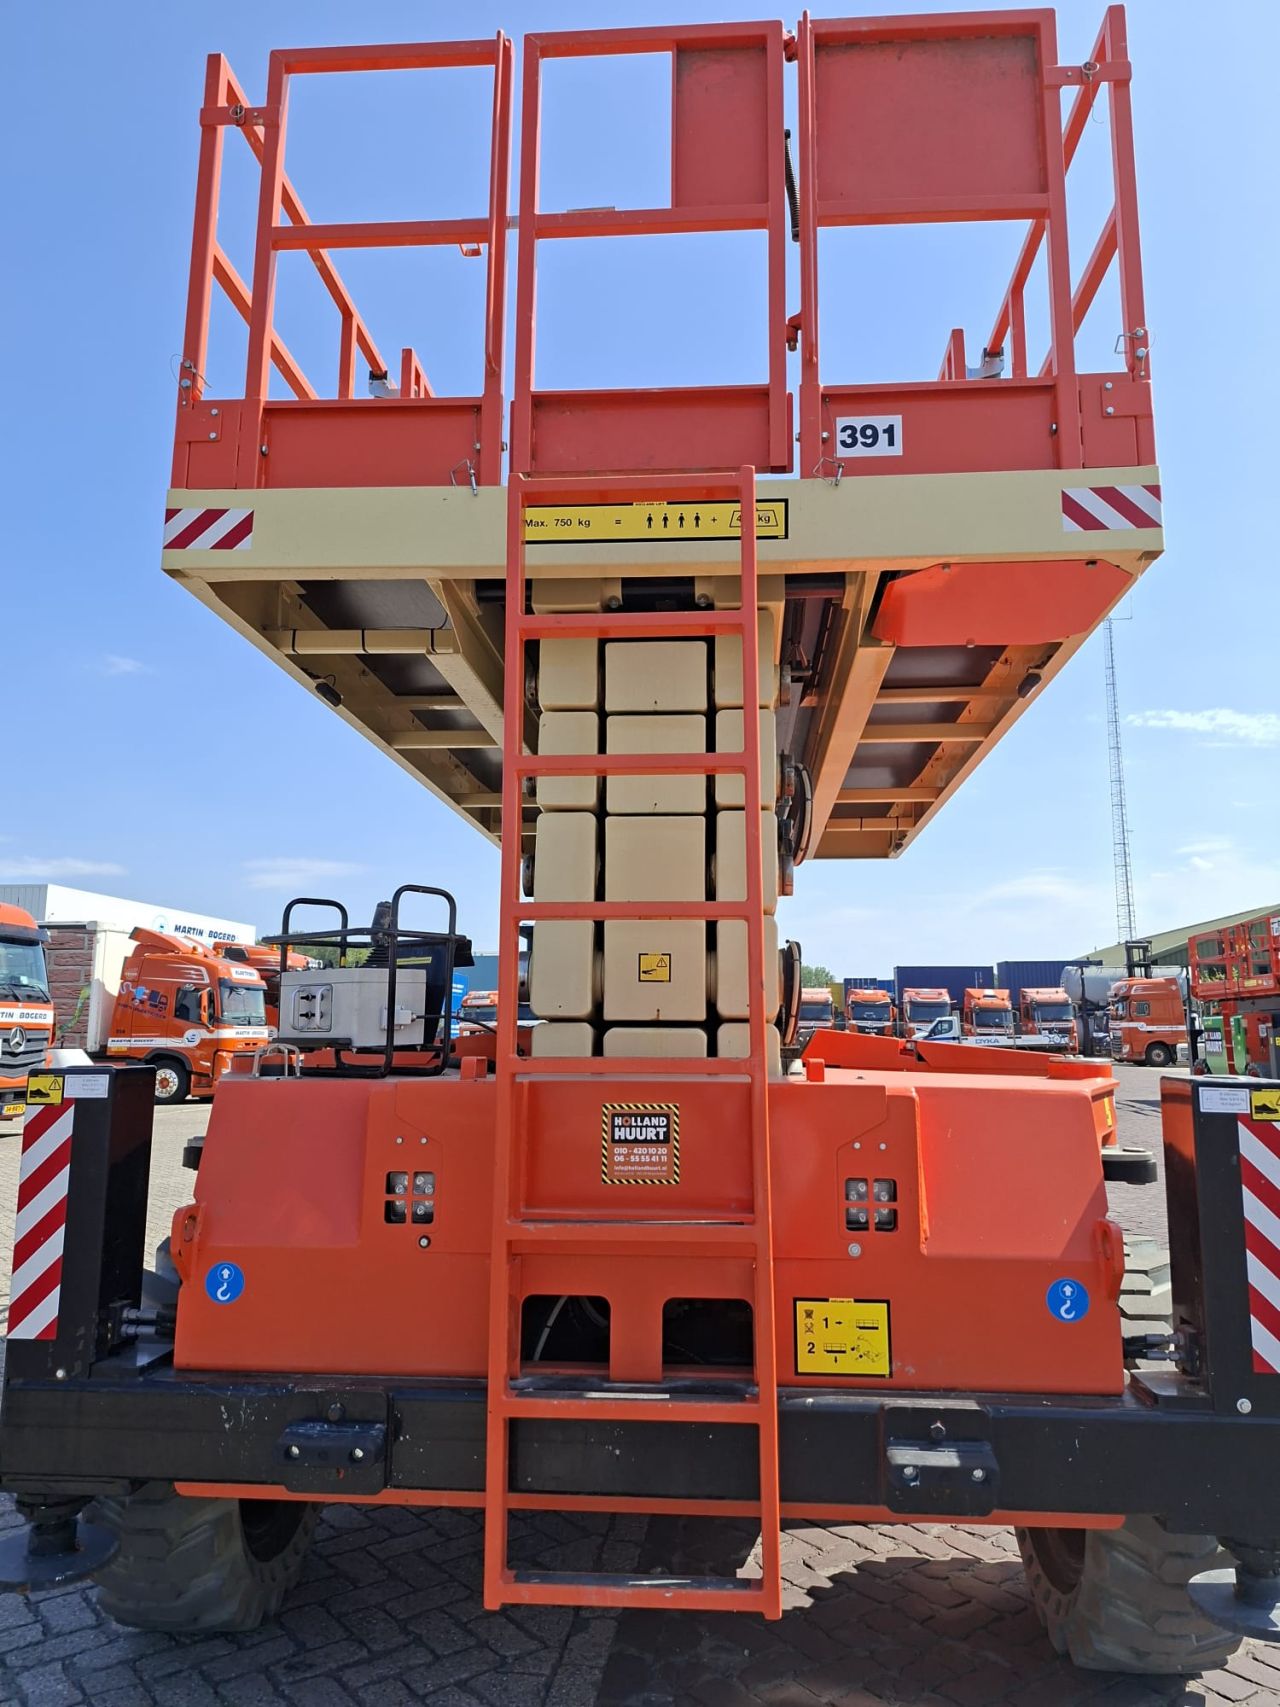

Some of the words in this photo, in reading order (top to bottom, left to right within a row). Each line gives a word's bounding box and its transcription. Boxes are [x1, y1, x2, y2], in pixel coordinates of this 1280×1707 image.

[840, 423, 895, 449] 391
[525, 519, 548, 527] Max.
[554, 518, 572, 527] 750
[578, 518, 591, 528] kg
[757, 513, 771, 523] kg
[174, 924, 204, 937] MARTIN
[614, 1116, 667, 1126] HOLLAND
[614, 1127, 667, 1140] HUURT
[822, 1316, 829, 1329] 1
[807, 1341, 815, 1354] 2
